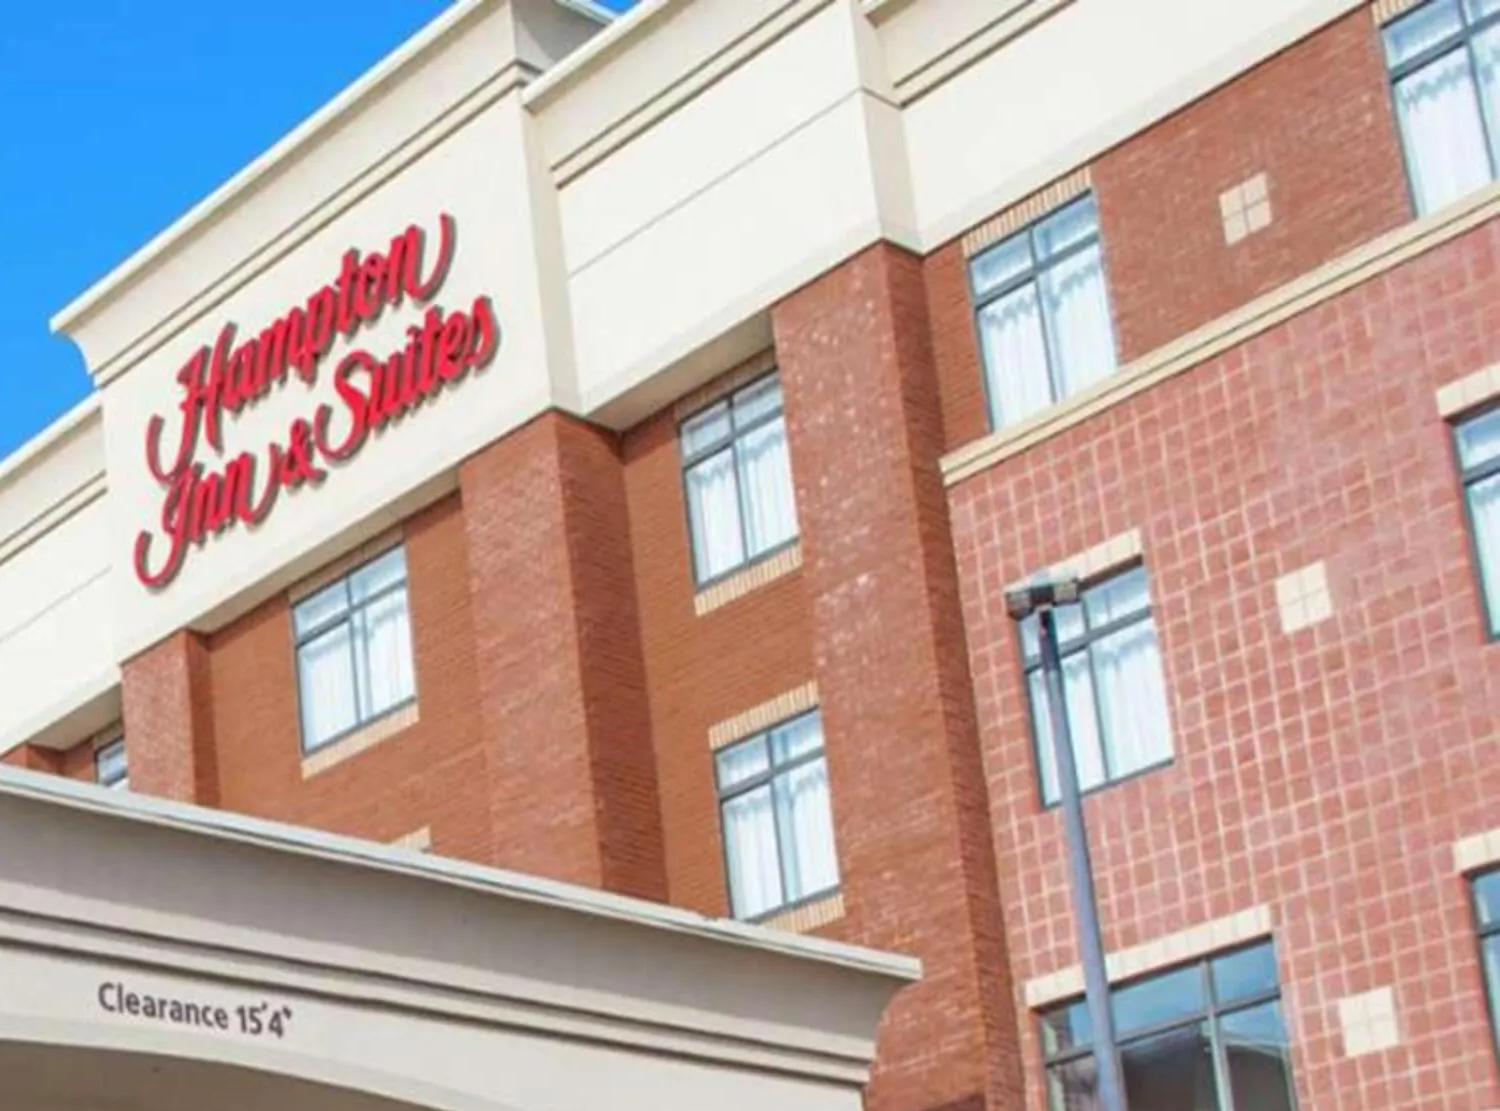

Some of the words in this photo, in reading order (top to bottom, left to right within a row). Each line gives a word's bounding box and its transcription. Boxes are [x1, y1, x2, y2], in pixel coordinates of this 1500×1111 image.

[134, 442, 282, 590] Inn
[280, 418, 326, 487] &
[314, 295, 500, 465] Suites
[146, 212, 455, 485] Hampton
[98, 982, 229, 1029] Clearance
